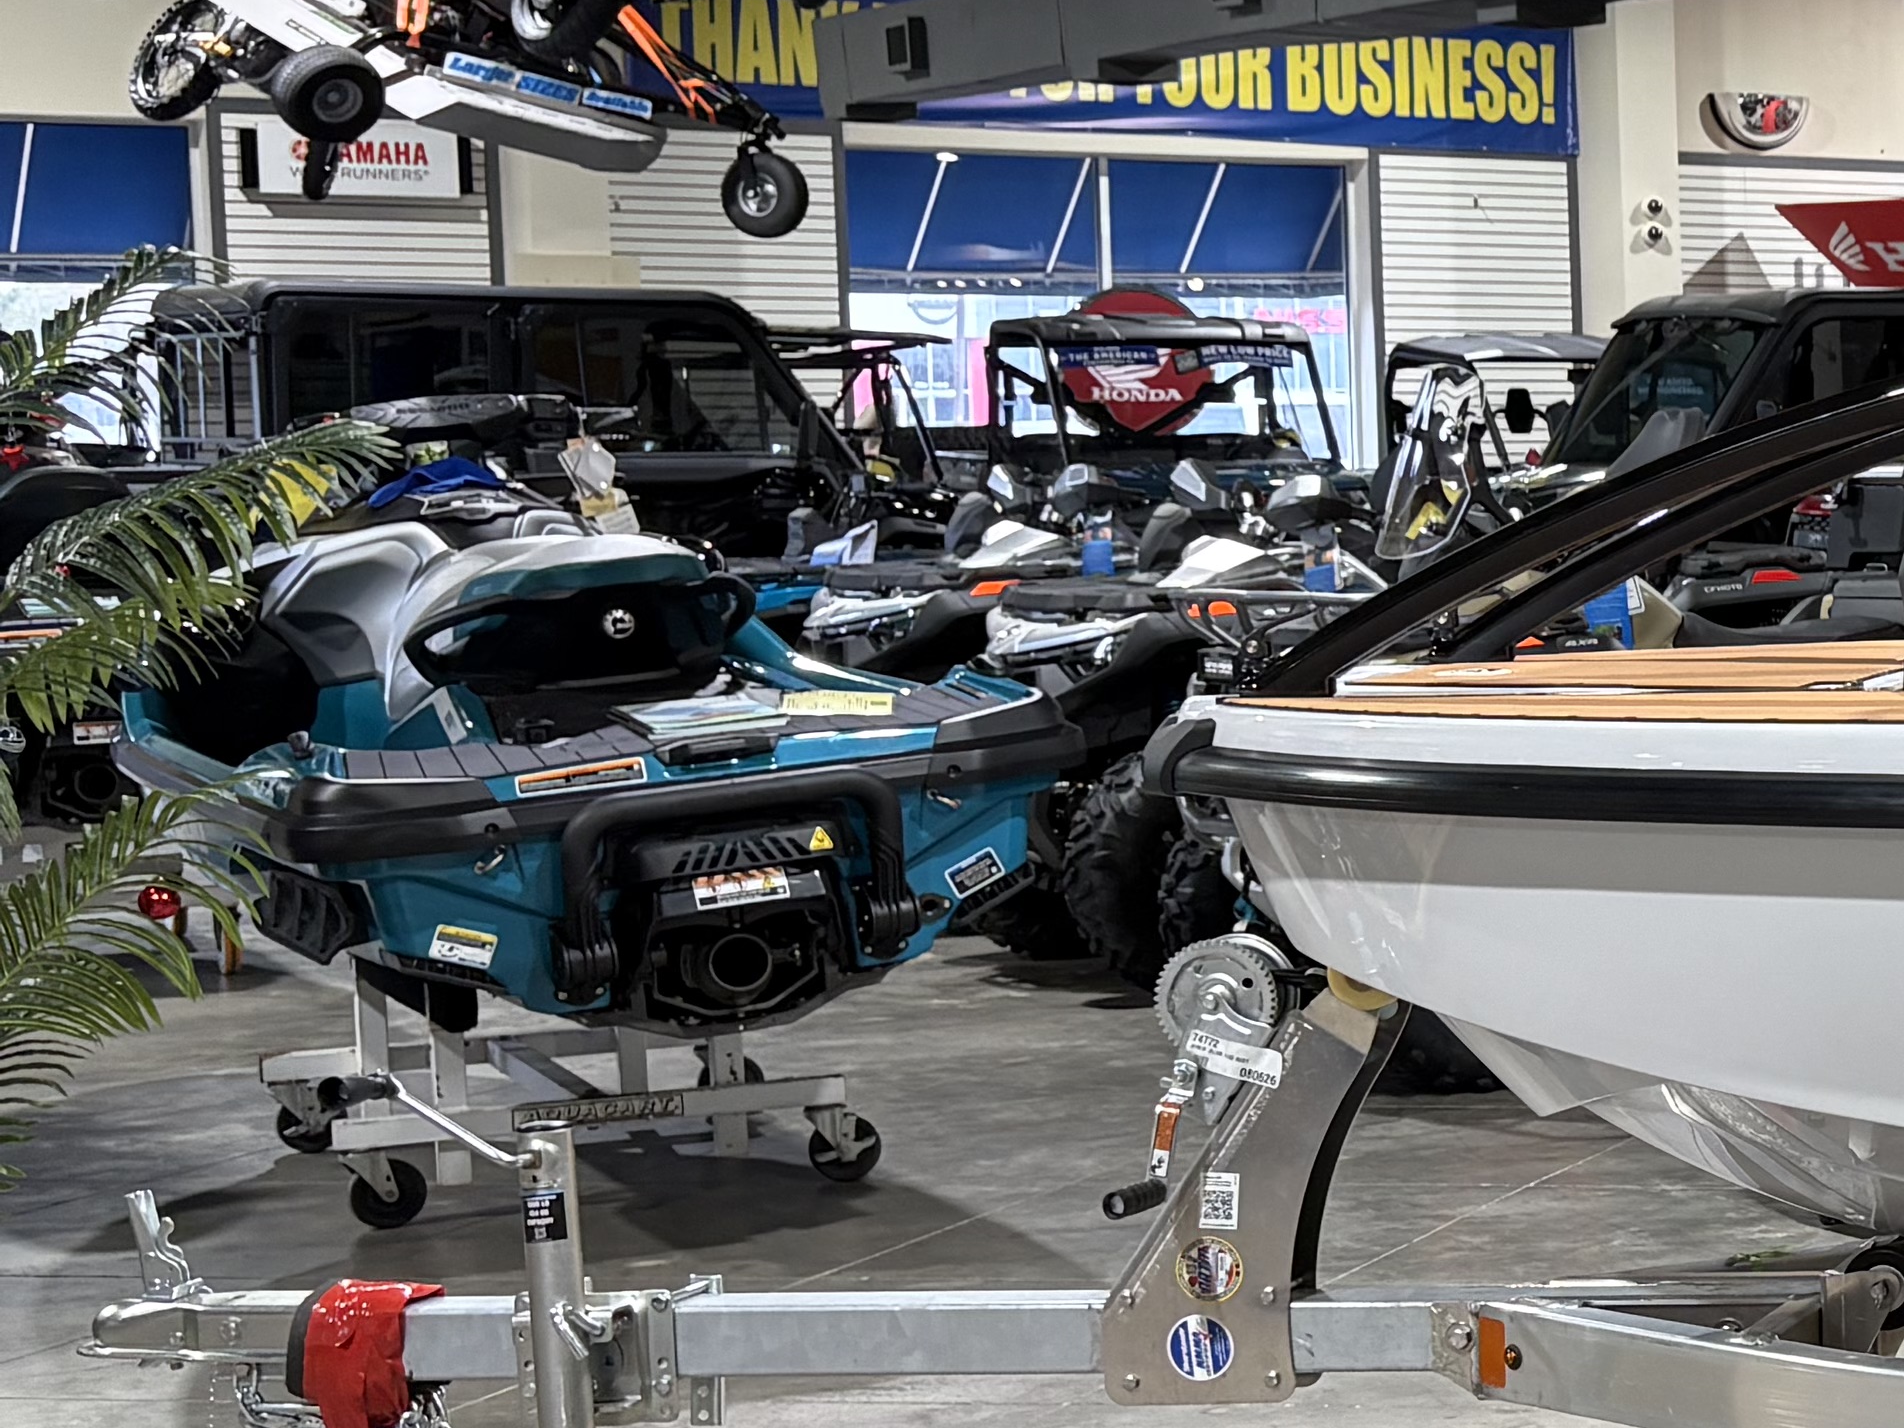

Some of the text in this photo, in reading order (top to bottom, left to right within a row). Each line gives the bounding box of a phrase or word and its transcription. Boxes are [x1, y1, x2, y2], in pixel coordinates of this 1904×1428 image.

[1137, 36, 1556, 124] OUR BUSINESS!
[338, 140, 429, 166] AMAHA
[1091, 386, 1184, 403] HONDA
